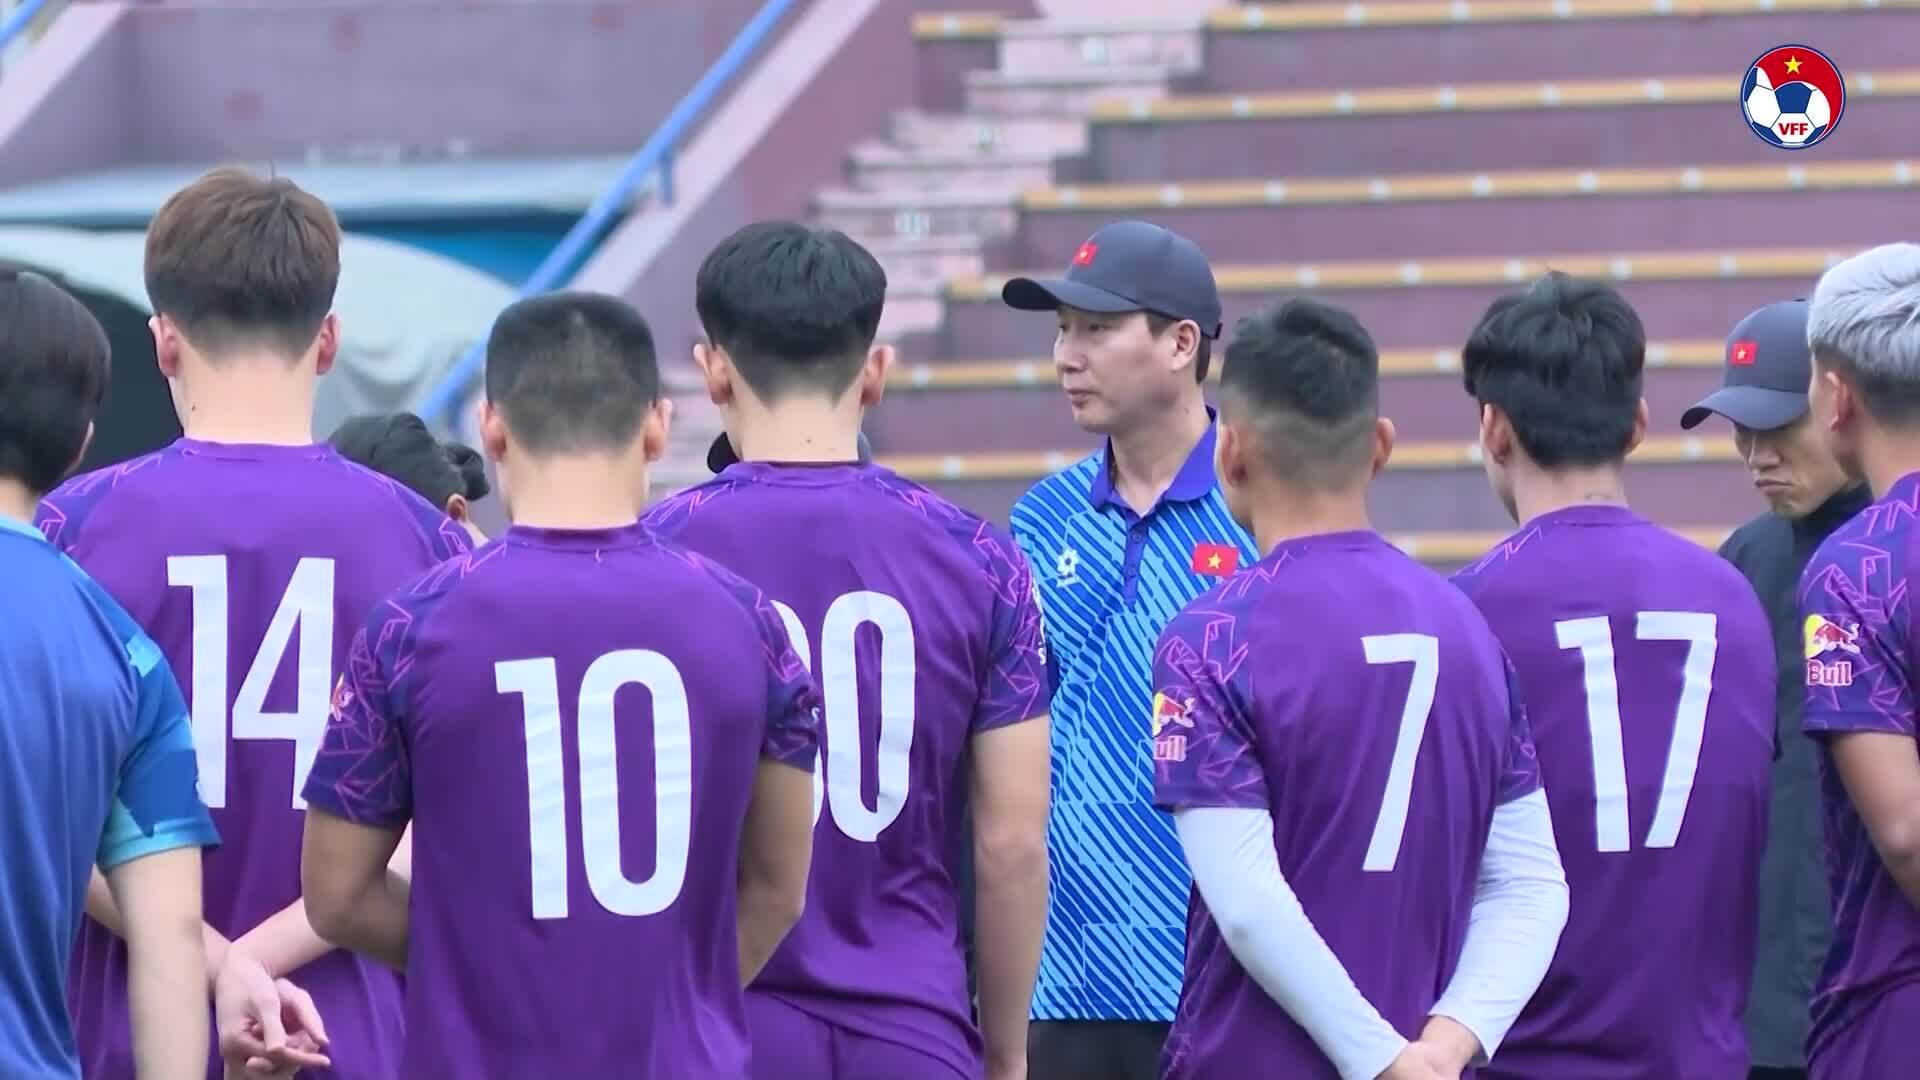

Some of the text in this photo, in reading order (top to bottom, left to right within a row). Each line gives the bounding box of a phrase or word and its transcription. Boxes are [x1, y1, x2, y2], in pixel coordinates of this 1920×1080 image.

[166, 554, 336, 810] 14
[494, 649, 692, 919] 10
[771, 590, 916, 842] 0
[1360, 634, 1439, 872] 7
[1554, 612, 1718, 852] 17
[1807, 658, 1852, 687] Bull
